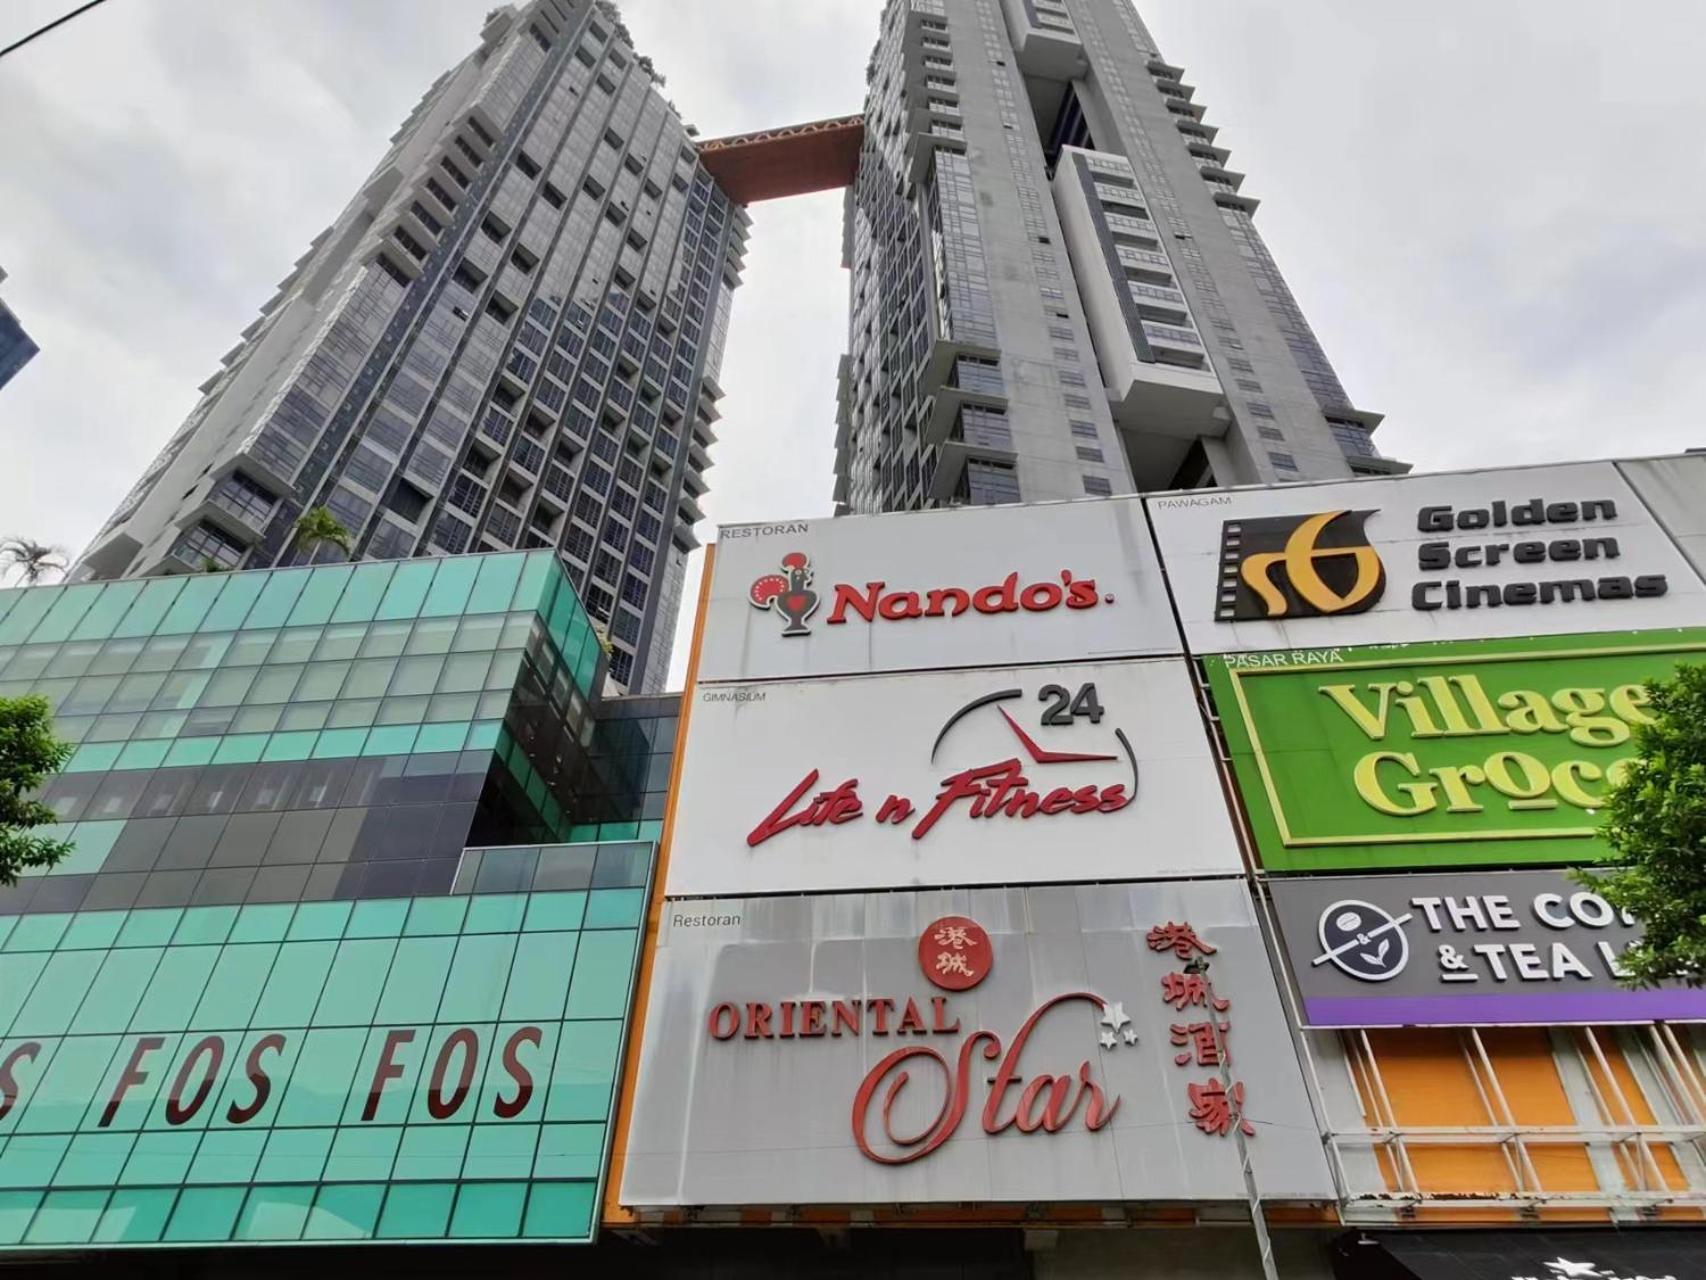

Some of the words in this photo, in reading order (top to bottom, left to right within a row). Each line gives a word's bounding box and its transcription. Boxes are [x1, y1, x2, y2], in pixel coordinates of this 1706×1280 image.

[1158, 492, 1232, 509] PAWAGAM
[1417, 497, 1618, 533] Golden
[720, 521, 809, 540] RESTORAN
[1417, 536, 1620, 571] Screen
[827, 569, 1099, 625] Nando's
[1411, 573, 1669, 611] Cinemas
[1223, 652, 1288, 669] PASAR
[1291, 649, 1344, 665] RAYA
[703, 691, 766, 702] GIMNASIUM
[1038, 682, 1105, 726] 24
[1319, 673, 1660, 747] Village
[875, 794, 916, 825] n
[911, 757, 1128, 840] Fitness
[672, 914, 742, 929] Restoran
[1411, 896, 1521, 931] THE
[1533, 892, 1636, 929] CO
[1473, 942, 1594, 982] TEA
[708, 996, 962, 1041] ORIENTAL
[98, 1034, 287, 1128] FOS
[361, 1026, 543, 1122] FOS
[851, 991, 1122, 1165] Star
